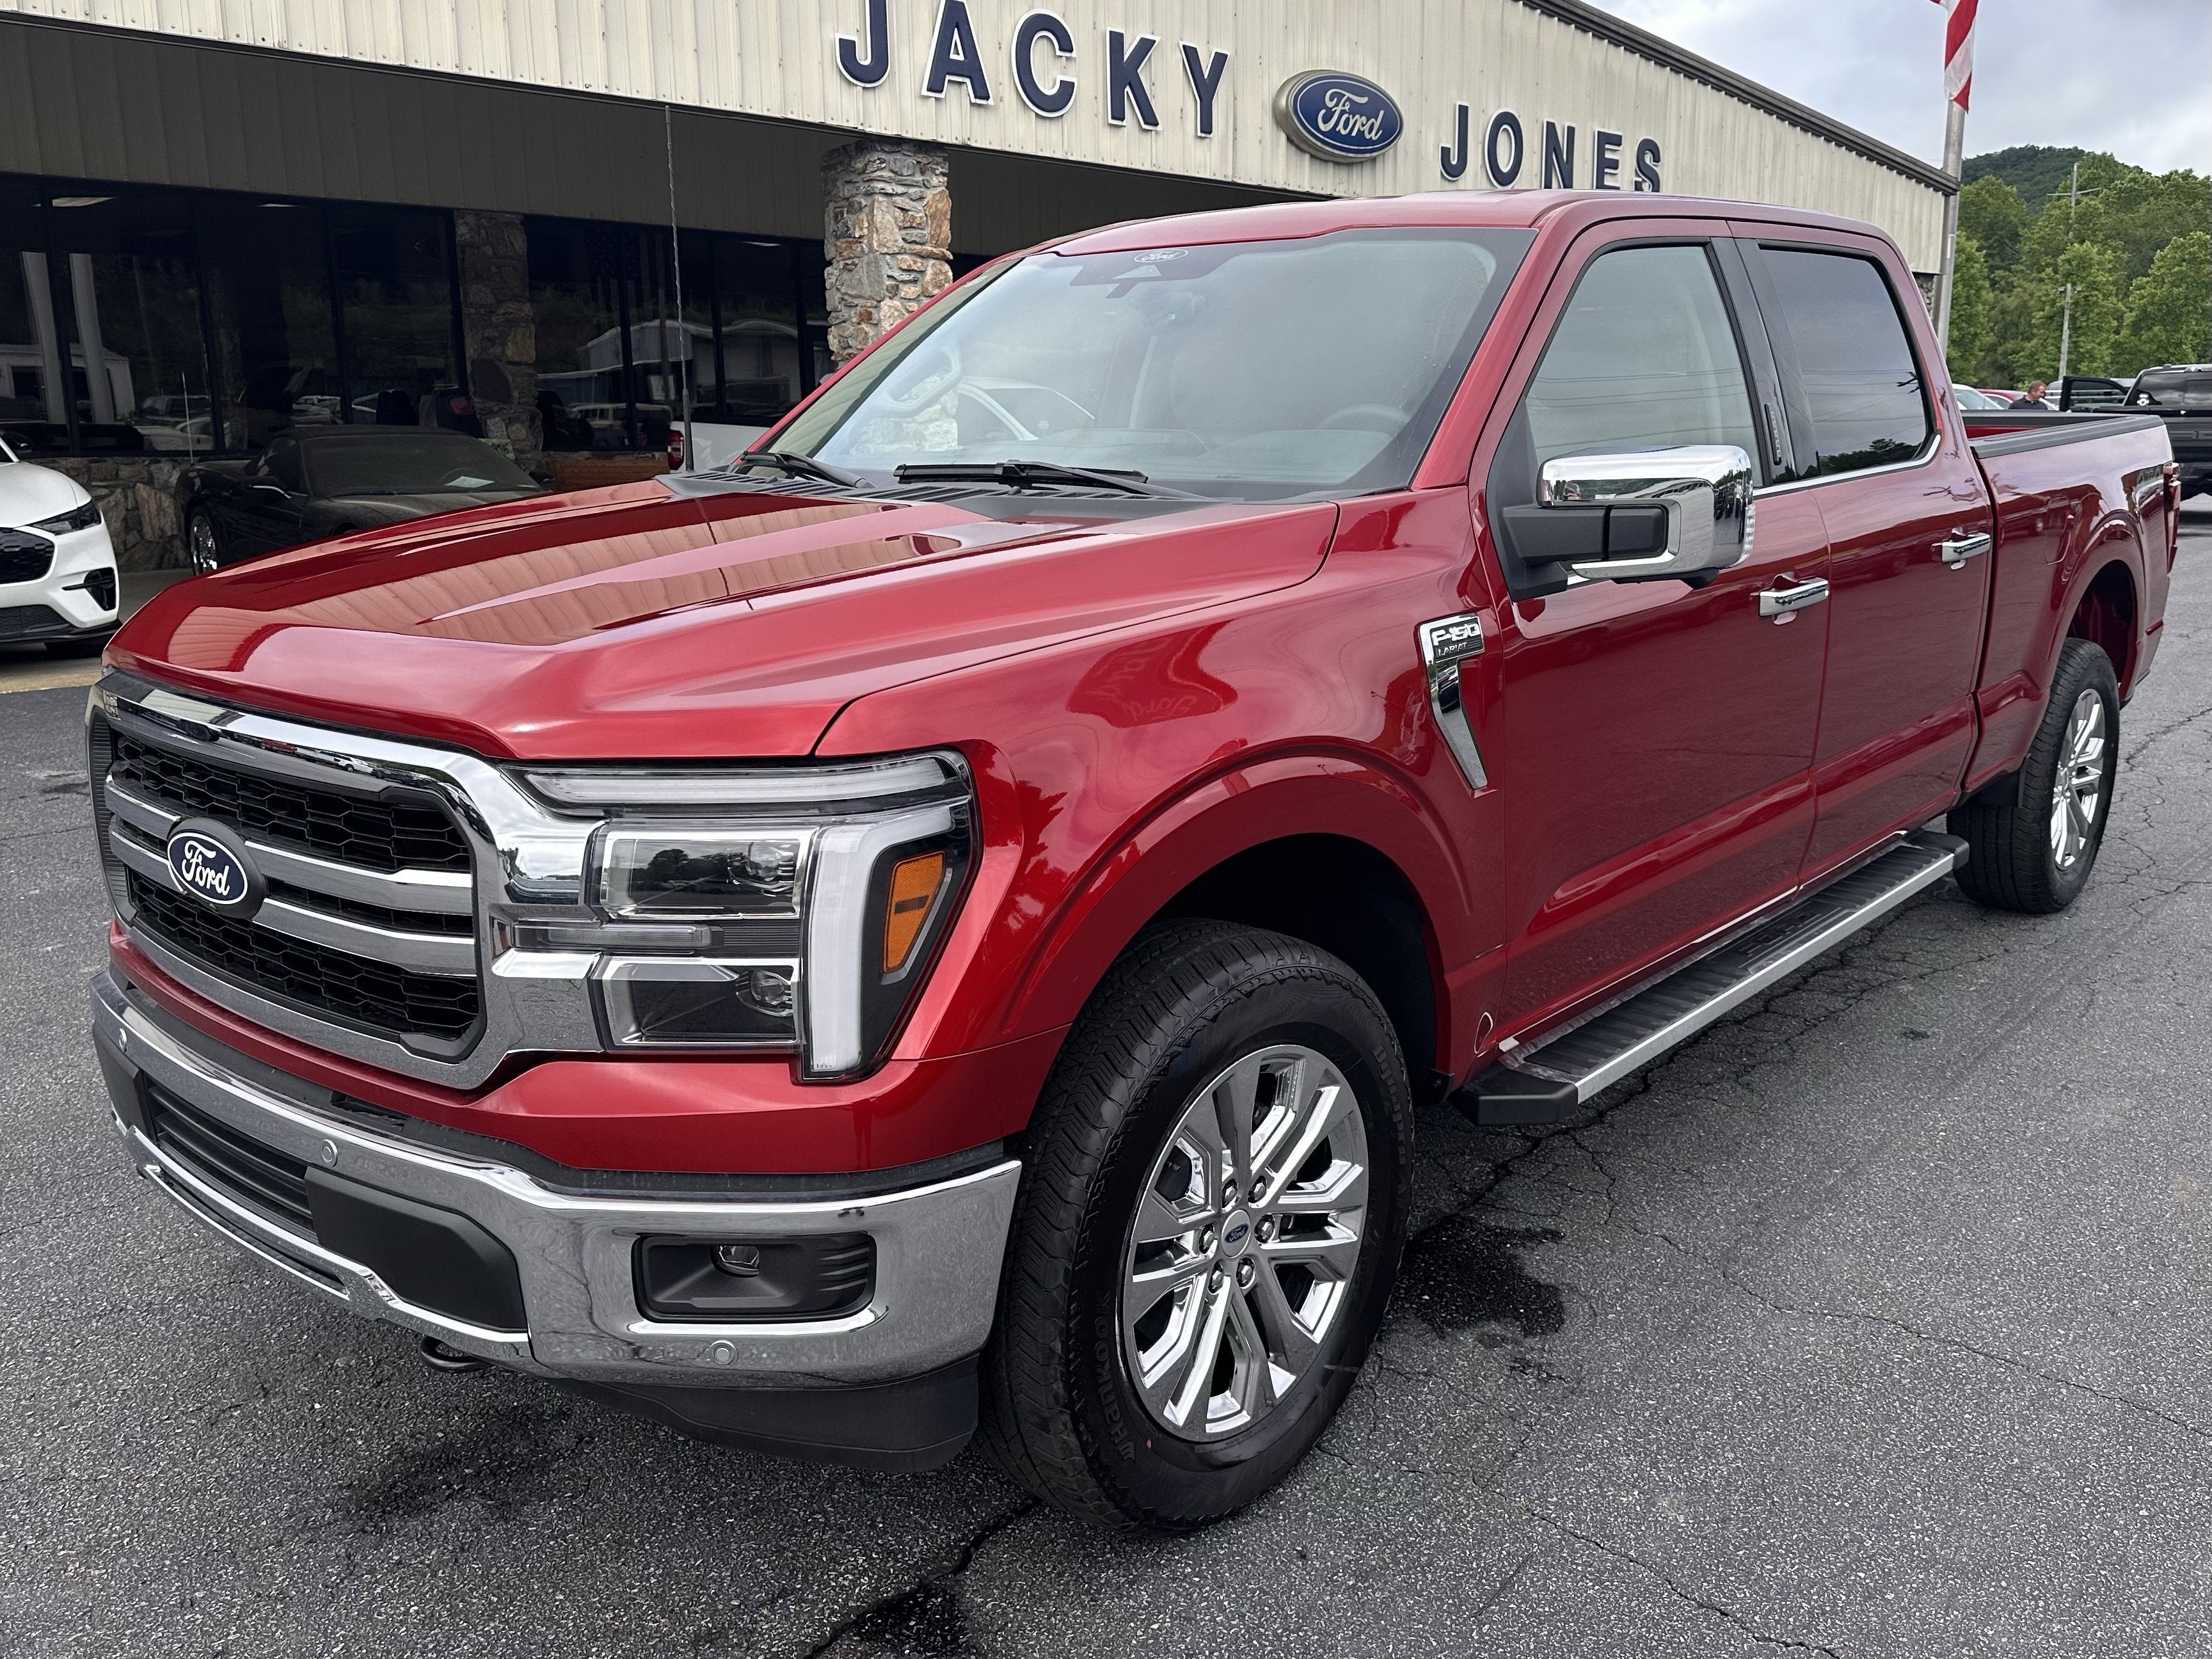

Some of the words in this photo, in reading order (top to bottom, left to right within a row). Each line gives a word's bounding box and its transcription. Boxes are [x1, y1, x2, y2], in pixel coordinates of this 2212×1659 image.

[835, 0, 1231, 138] JACKY
[1438, 100, 1662, 192] JONES
[1317, 88, 1385, 141] Ford
[1438, 642, 1468, 656] LARIAT
[182, 840, 230, 896] Ford
[1229, 1226, 1246, 1242] Ford
